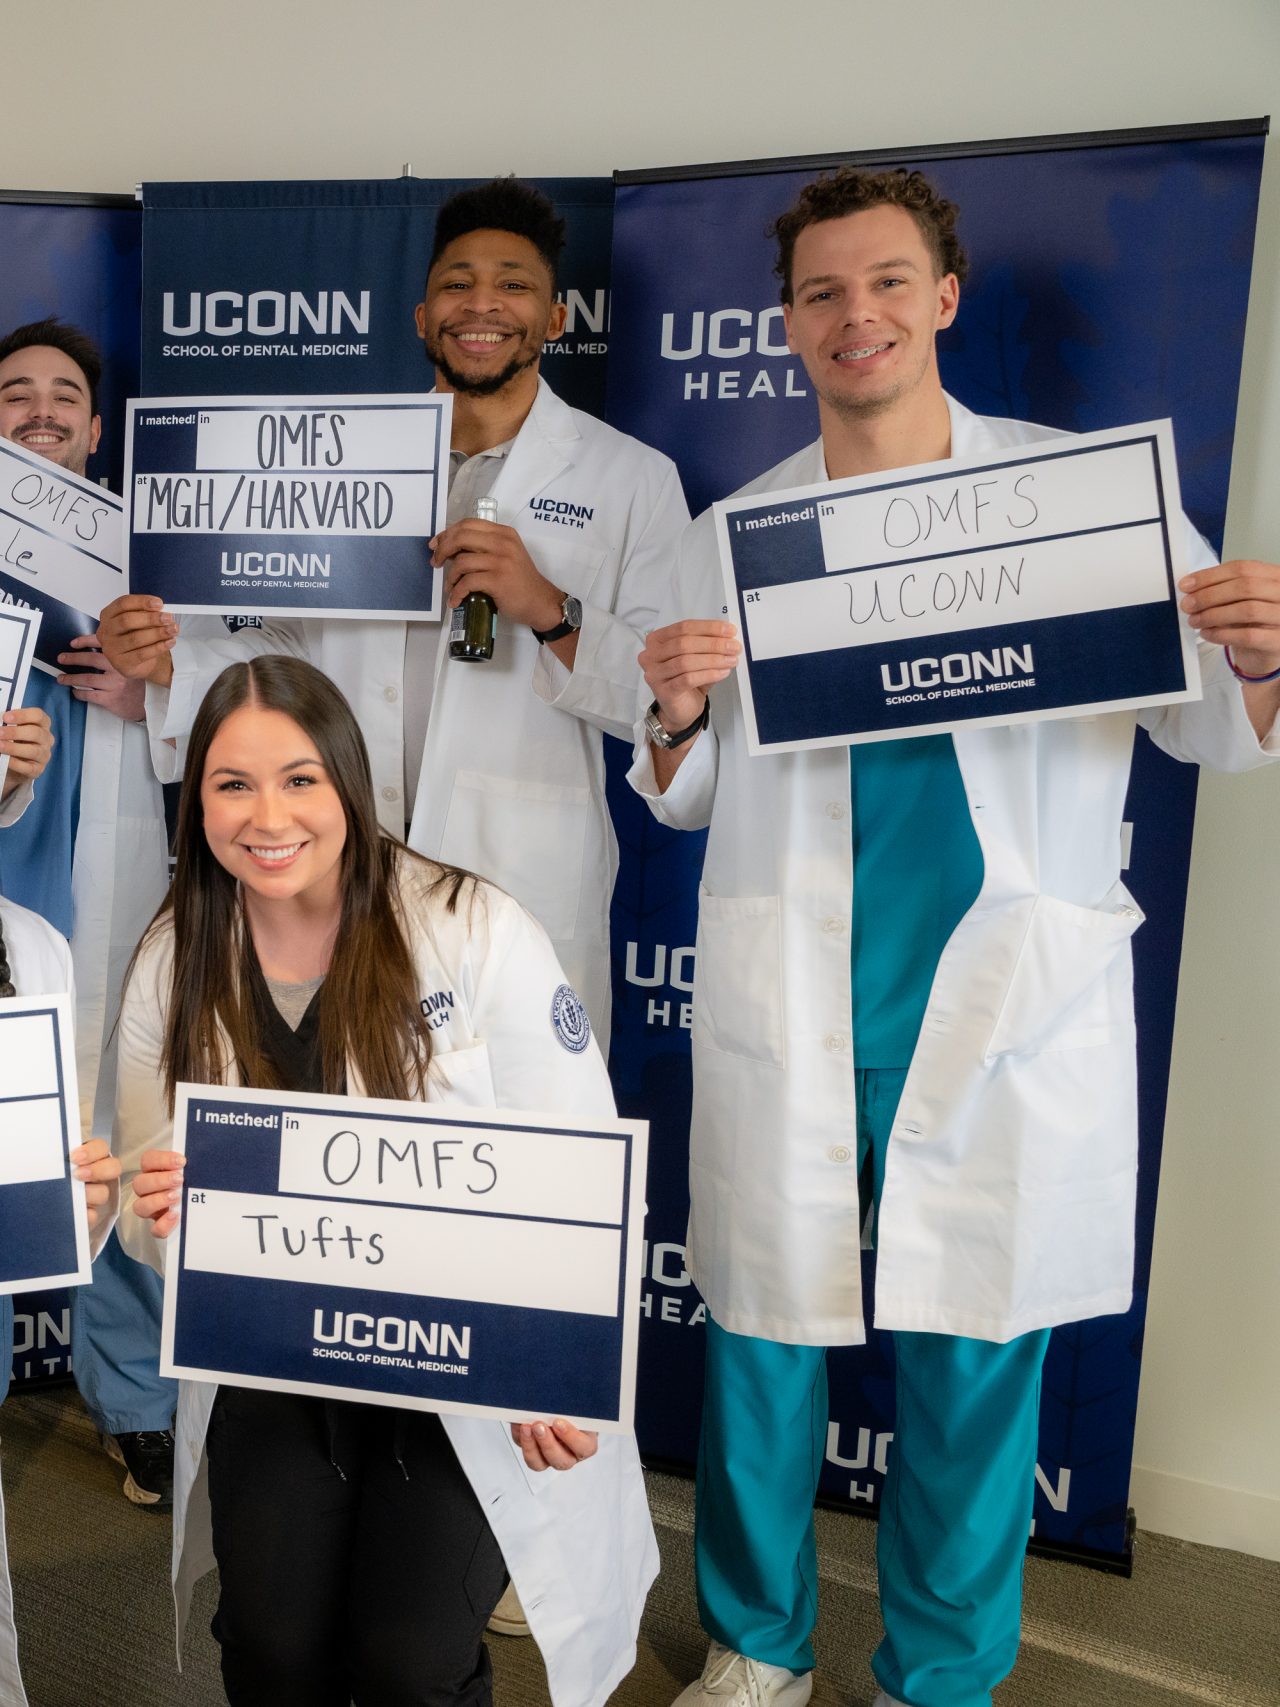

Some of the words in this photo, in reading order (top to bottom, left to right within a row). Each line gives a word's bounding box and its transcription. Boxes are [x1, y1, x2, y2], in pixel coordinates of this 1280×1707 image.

[163, 291, 370, 336] UCONN
[661, 307, 791, 360] UCO
[163, 345, 218, 356] SCHOOL
[221, 345, 241, 356] OF
[243, 345, 298, 356] DENTAL
[302, 345, 368, 355] MEDICINE
[684, 369, 807, 400] HEAL
[146, 413, 196, 426] matched!
[200, 413, 210, 424] in
[257, 413, 346, 470] OMFS
[137, 476, 147, 485] at
[11, 474, 109, 541] OMFS
[147, 474, 394, 531] MGH/HARVARD
[529, 497, 595, 521] UCONN
[883, 474, 1039, 549] OMFS
[534, 512, 584, 529] HEALTH
[736, 520, 742, 532] I
[745, 507, 815, 531] matched!
[821, 504, 835, 517] in
[221, 551, 331, 577] UCONN
[220, 579, 251, 587] SCHOOL
[263, 580, 292, 588] DENTAL
[293, 581, 330, 589] MEDICINE
[746, 591, 761, 603] at
[844, 557, 1026, 625] UCONN
[880, 644, 1035, 692] UCONN
[885, 693, 926, 706] SCHOOL
[927, 690, 942, 700] OF
[943, 685, 984, 698] DENTAL
[985, 678, 1036, 692] MEDICINE
[419, 991, 455, 1018] ONN
[195, 1108, 201, 1123] I
[205, 1110, 279, 1130] matched!
[285, 1116, 299, 1130] in
[322, 1130, 498, 1195] OMFS
[190, 1191, 206, 1204] at
[241, 1214, 385, 1266] Tufts
[640, 1293, 706, 1326] HEA
[313, 1308, 471, 1360] UCONN
[312, 1347, 356, 1362] SCHOOL
[356, 1352, 372, 1364] OF
[372, 1355, 415, 1369] DENTAL
[416, 1360, 469, 1376] MEDICINE
